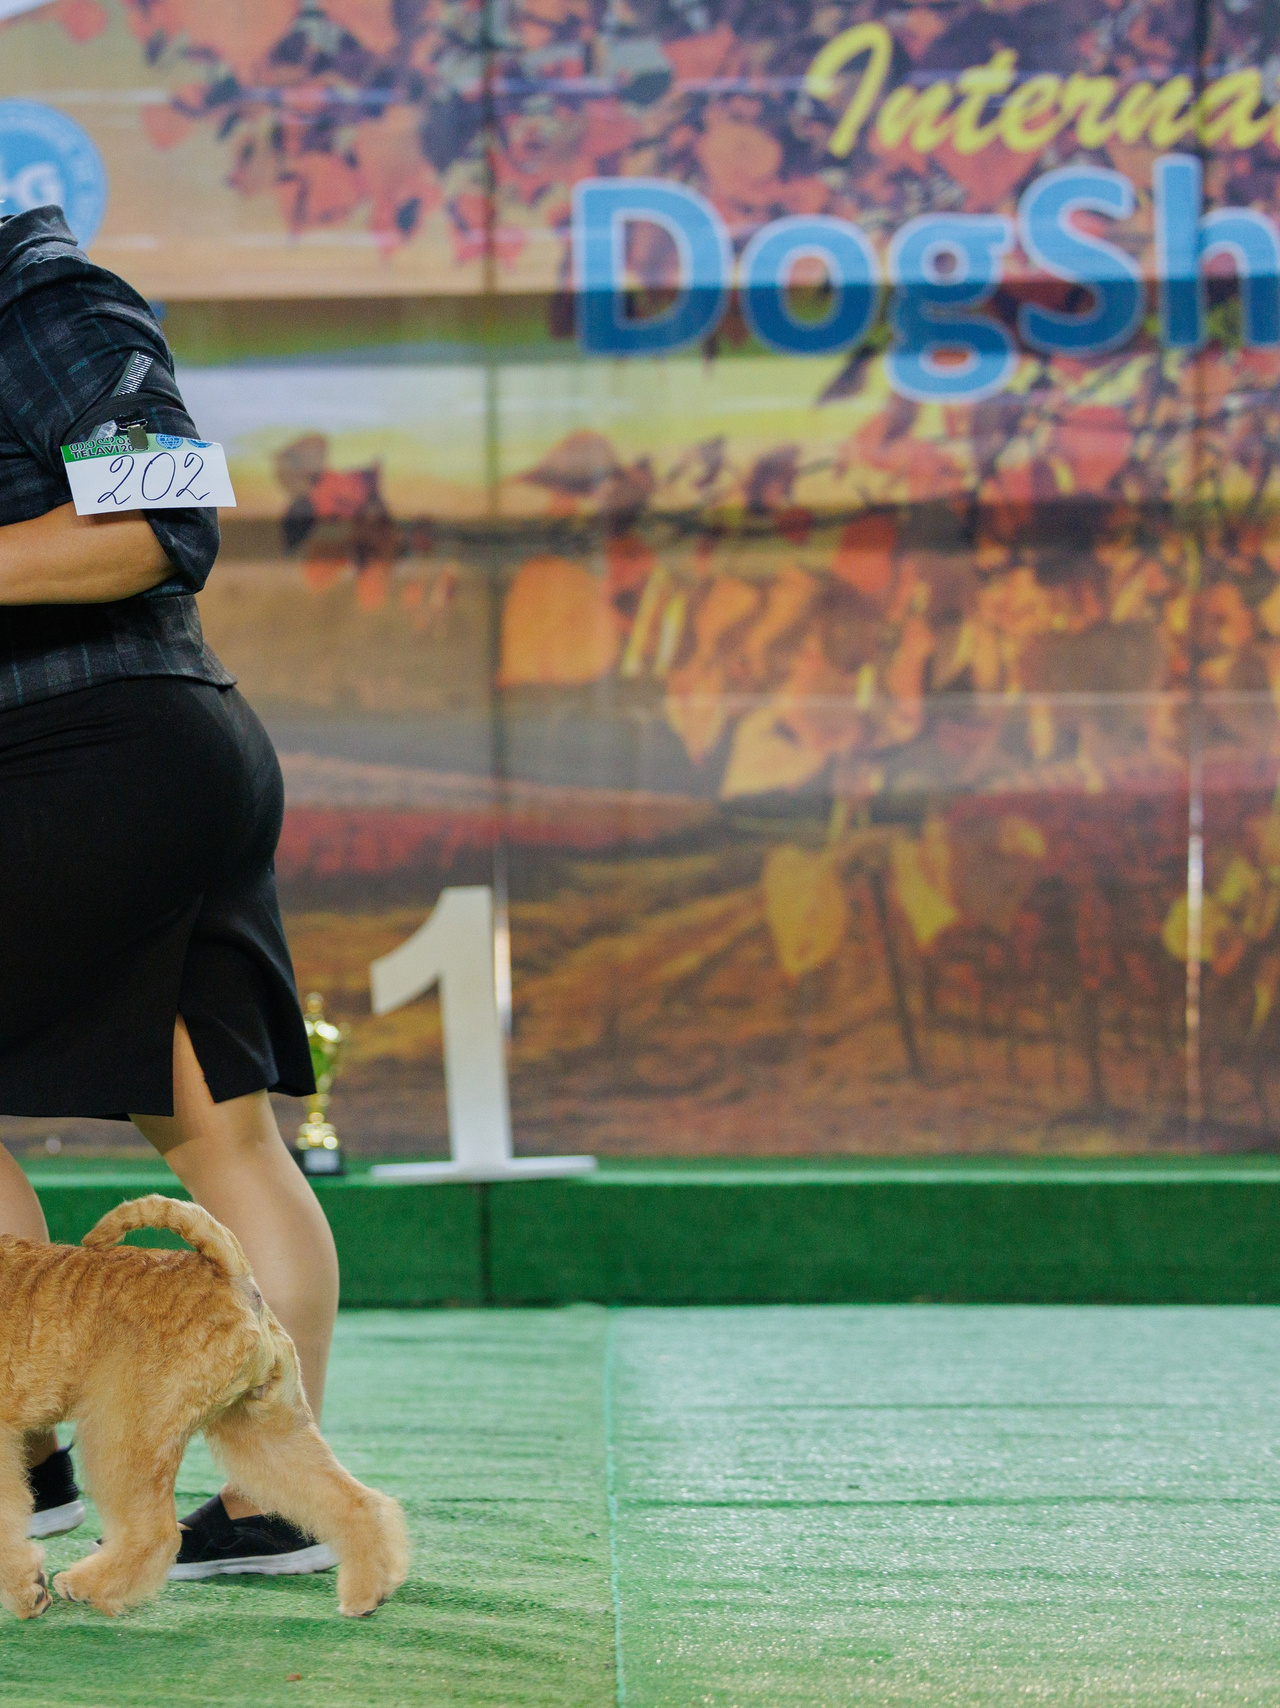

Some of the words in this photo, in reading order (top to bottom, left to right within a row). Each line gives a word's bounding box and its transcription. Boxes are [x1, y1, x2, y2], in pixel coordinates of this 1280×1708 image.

[806, 22, 1280, 157] Interna
[572, 154, 1280, 402] DogSh
[72, 445, 120, 459] TELAVI
[97, 452, 210, 505] 202
[371, 885, 513, 1165] 1
